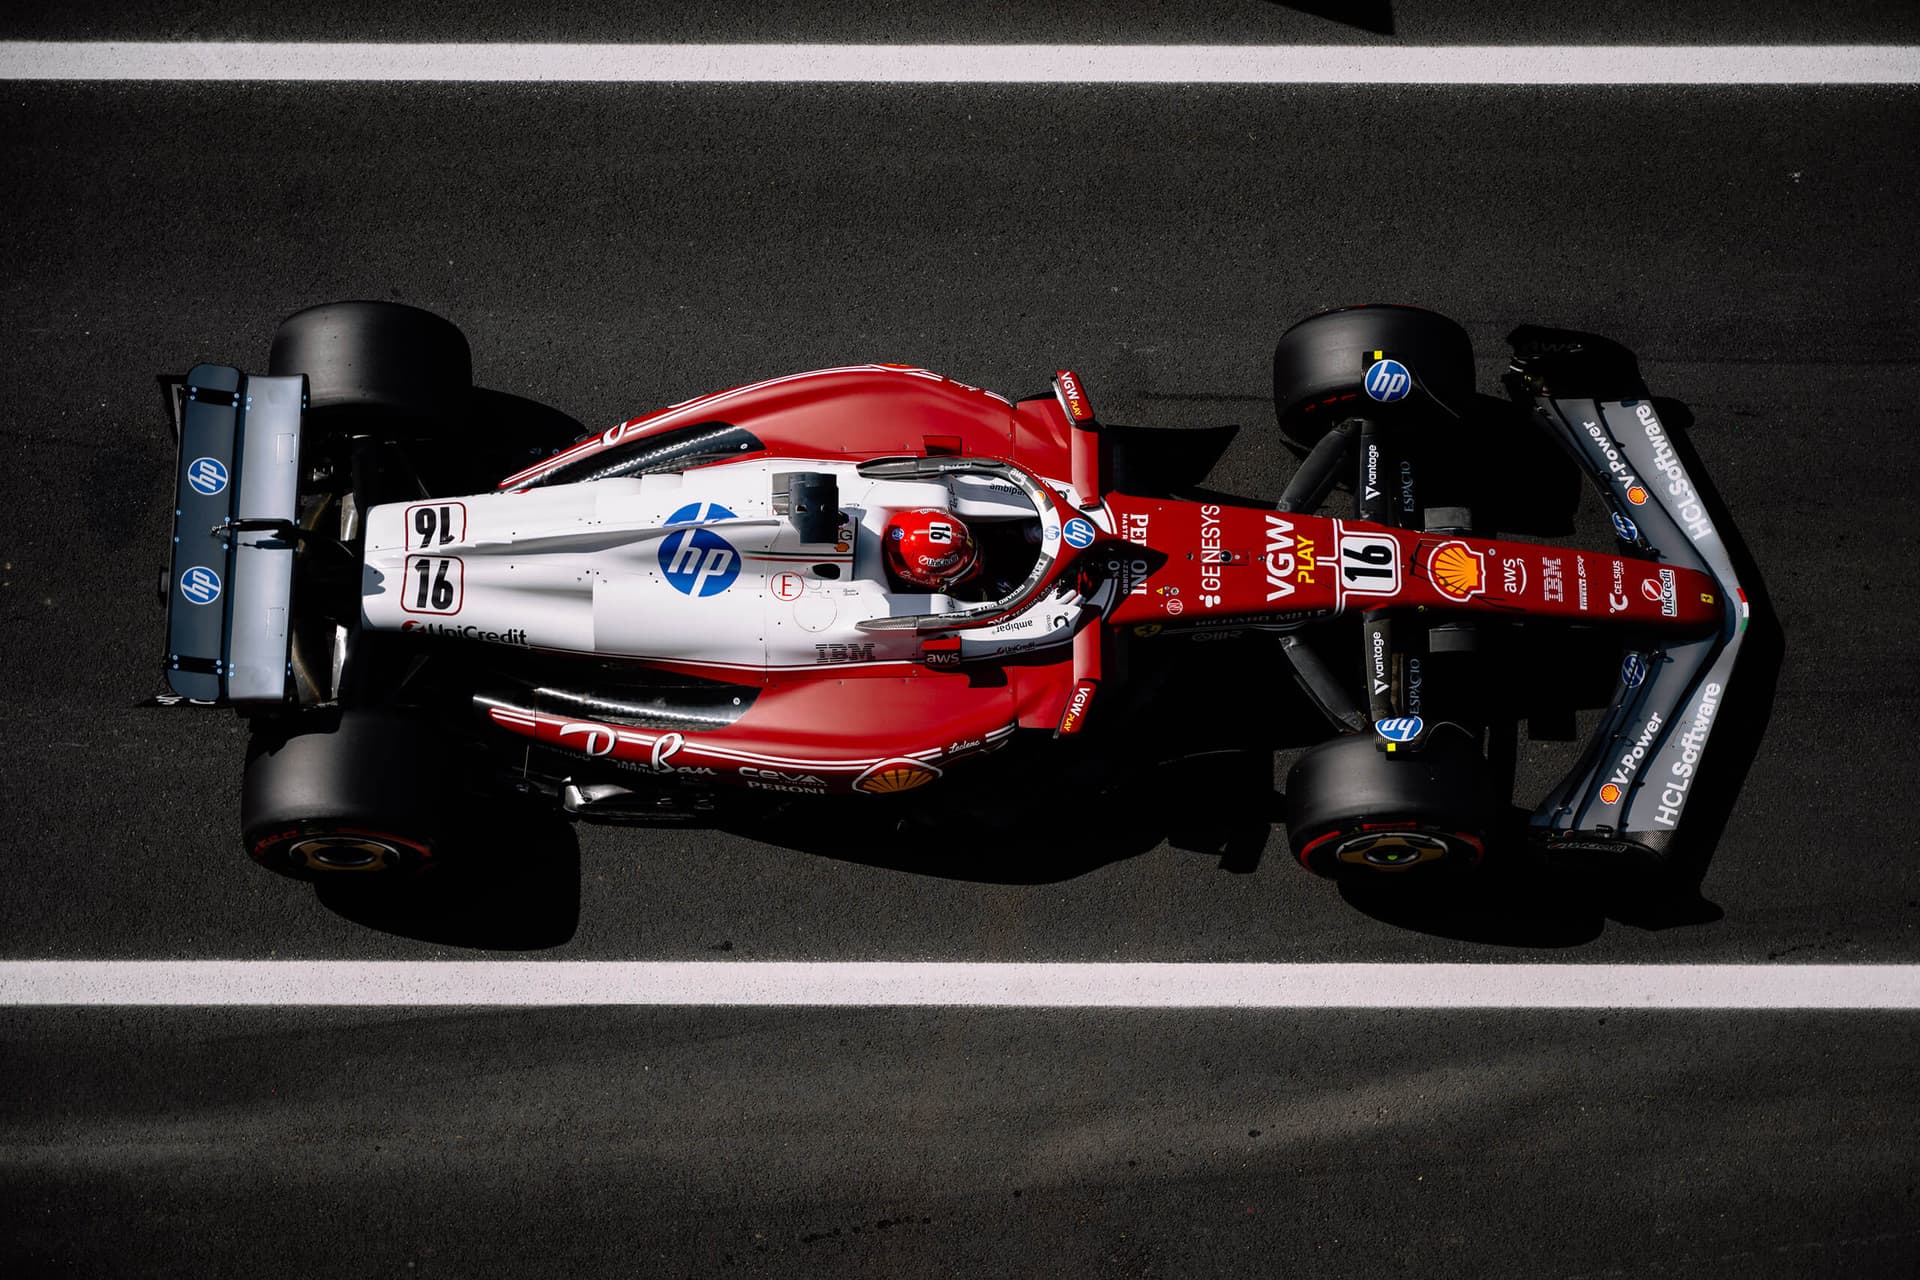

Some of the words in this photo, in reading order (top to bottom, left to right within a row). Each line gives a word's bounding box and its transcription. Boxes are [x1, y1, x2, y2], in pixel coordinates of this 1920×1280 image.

[1061, 371, 1080, 400] VGW
[1071, 400, 1083, 416] PLAY
[1370, 362, 1408, 401] hp
[1369, 444, 1380, 486] vantage
[1583, 421, 1635, 489] V-Power
[1636, 404, 1713, 541] HCLSoftware
[189, 460, 228, 492] hp
[415, 506, 456, 549] 16
[930, 525, 951, 541] 16
[1064, 520, 1094, 547] hp
[667, 528, 734, 599] hp
[1130, 513, 1149, 595] PEONI
[1201, 505, 1221, 591] GENESYS
[1265, 515, 1295, 602] VGW
[1297, 535, 1315, 584] PLAY
[1343, 545, 1393, 582] 16
[181, 568, 221, 602] hp
[414, 558, 455, 610] 16
[781, 575, 793, 597] E
[1503, 558, 1518, 593] aws
[1542, 556, 1563, 603] IBM
[1612, 560, 1622, 595] CELSIUS
[1661, 570, 1674, 616] UniCredit
[427, 623, 528, 645] UniCredit
[996, 619, 1033, 633] ambipar
[816, 643, 876, 664] IBM
[926, 652, 960, 665] aws
[1372, 631, 1384, 678] vantage
[1070, 687, 1091, 717] VGW
[1063, 713, 1076, 732] PLAY
[1378, 717, 1418, 741] hp
[1611, 711, 1663, 785] V-Power
[1654, 682, 1721, 827] HCLSoftware
[747, 780, 826, 796] PERONI
